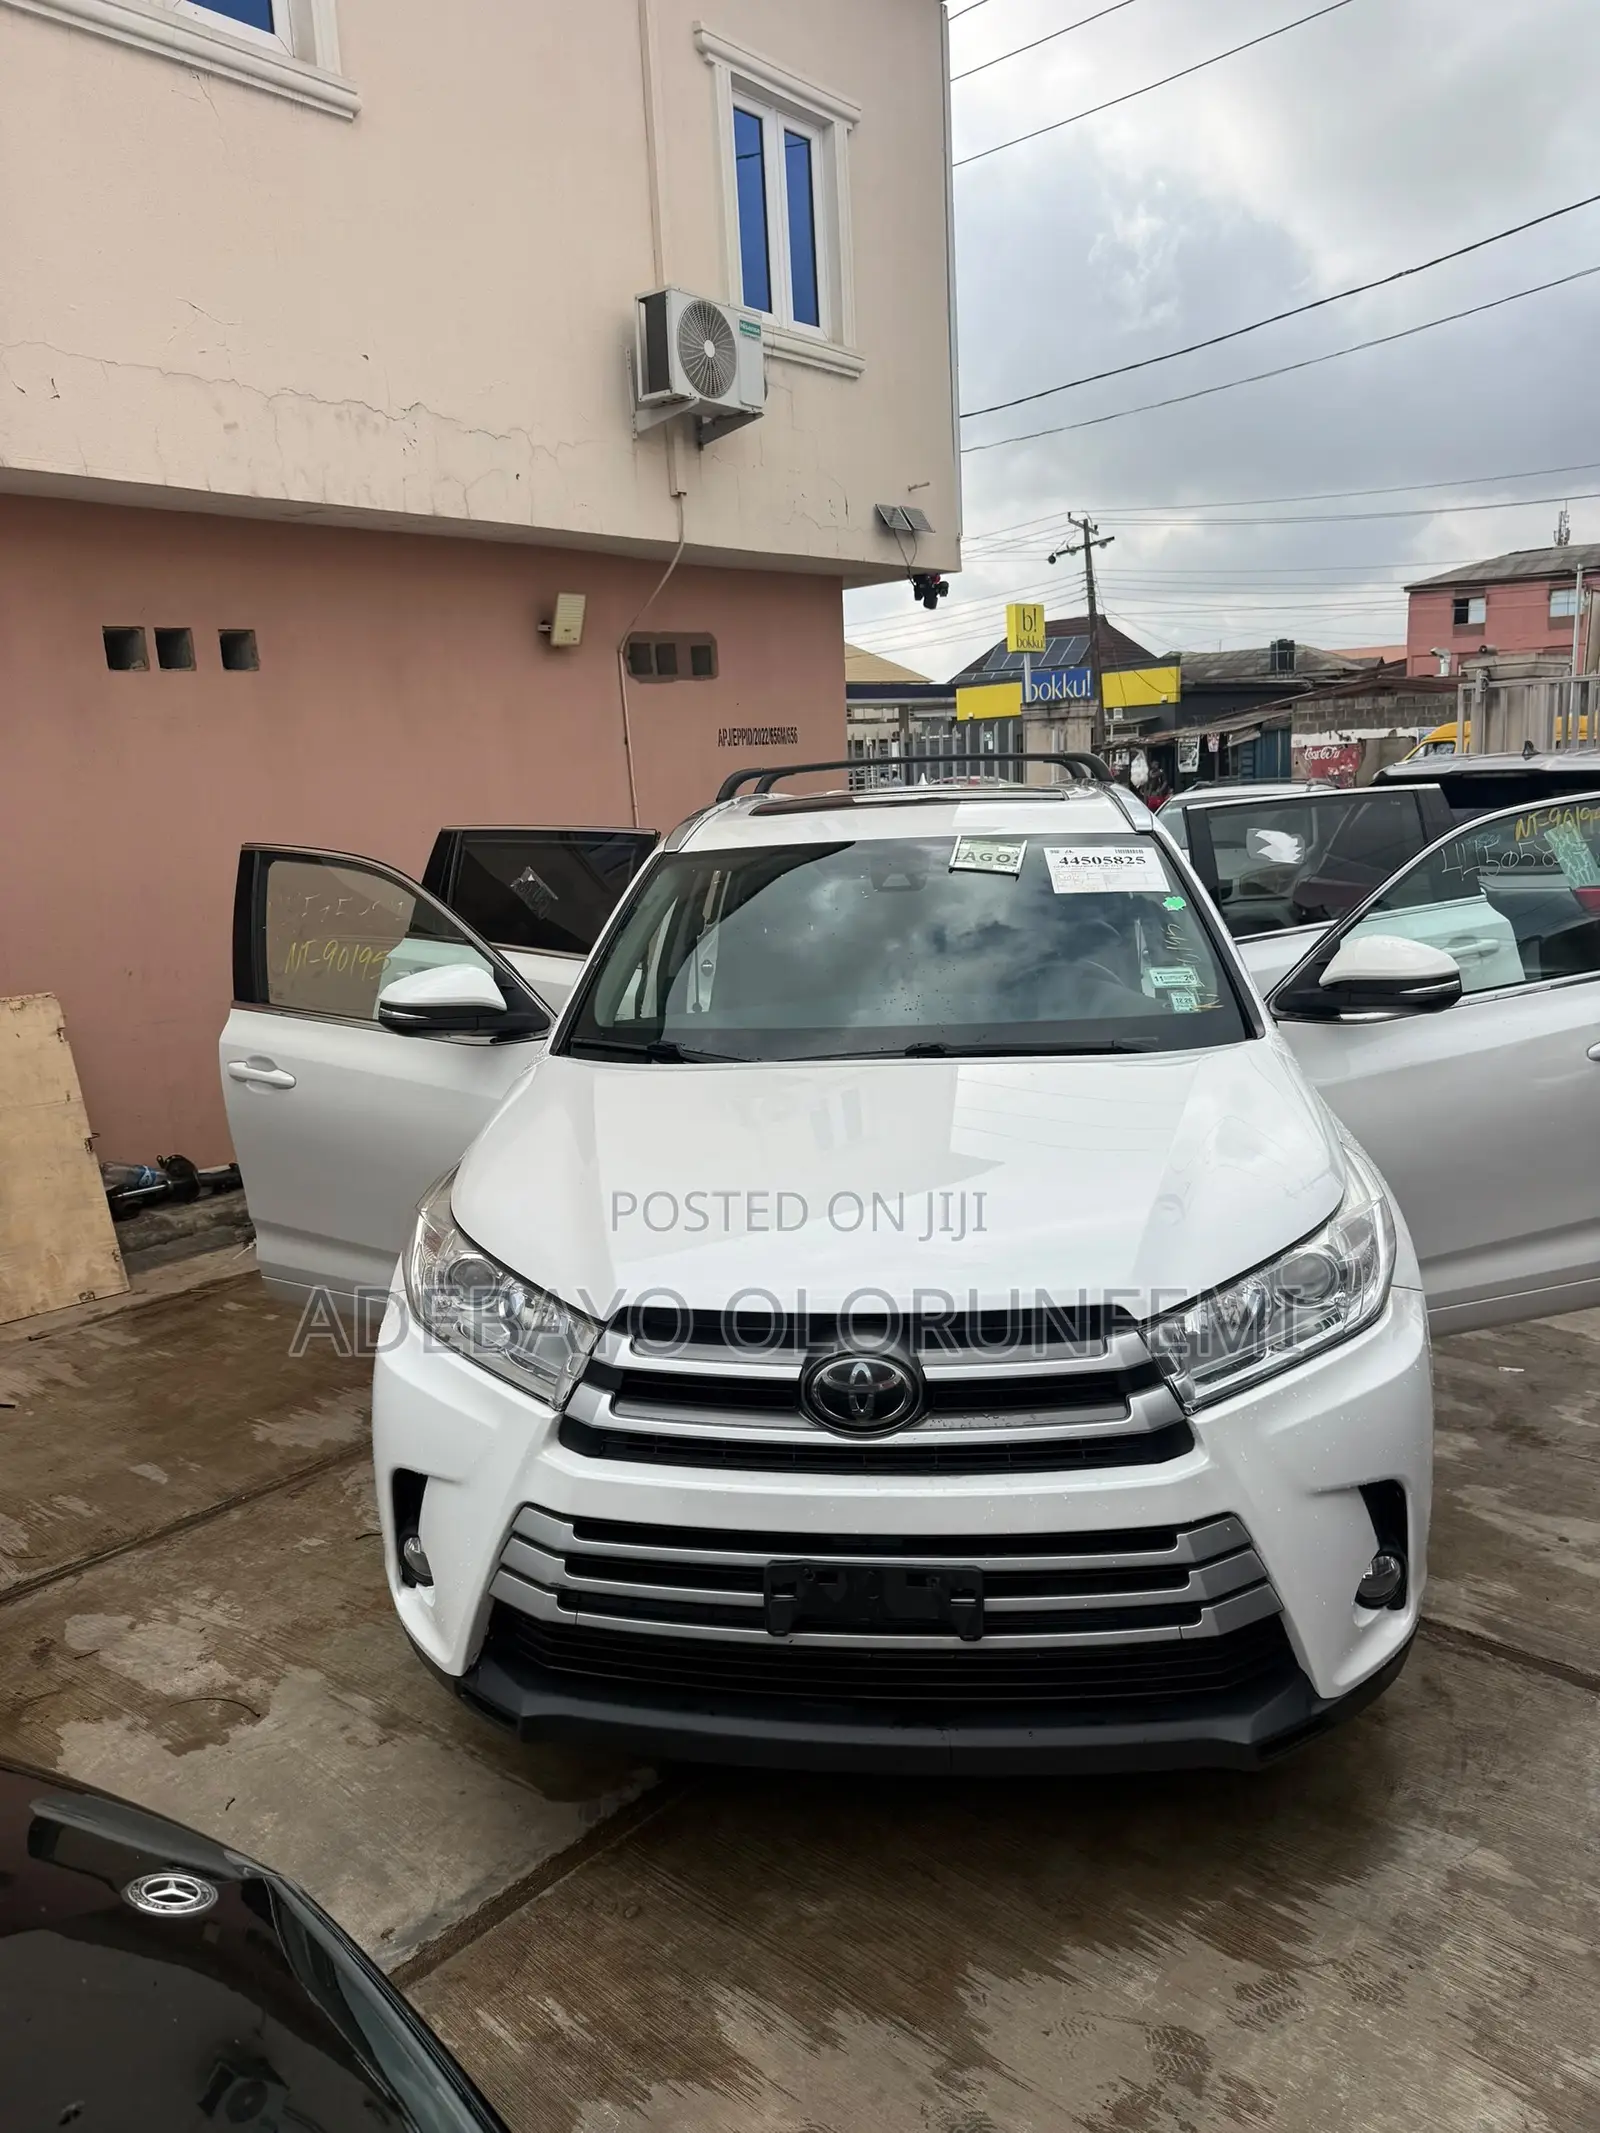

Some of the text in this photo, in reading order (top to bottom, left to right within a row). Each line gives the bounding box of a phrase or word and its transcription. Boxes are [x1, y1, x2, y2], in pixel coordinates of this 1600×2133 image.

[1022, 607, 1037, 632] b!
[1016, 634, 1045, 649] bokku!
[1515, 805, 1600, 842] NT-9019
[957, 847, 1019, 865] AGO
[1059, 855, 1147, 866] 44505825
[284, 939, 392, 982] NT-90195
